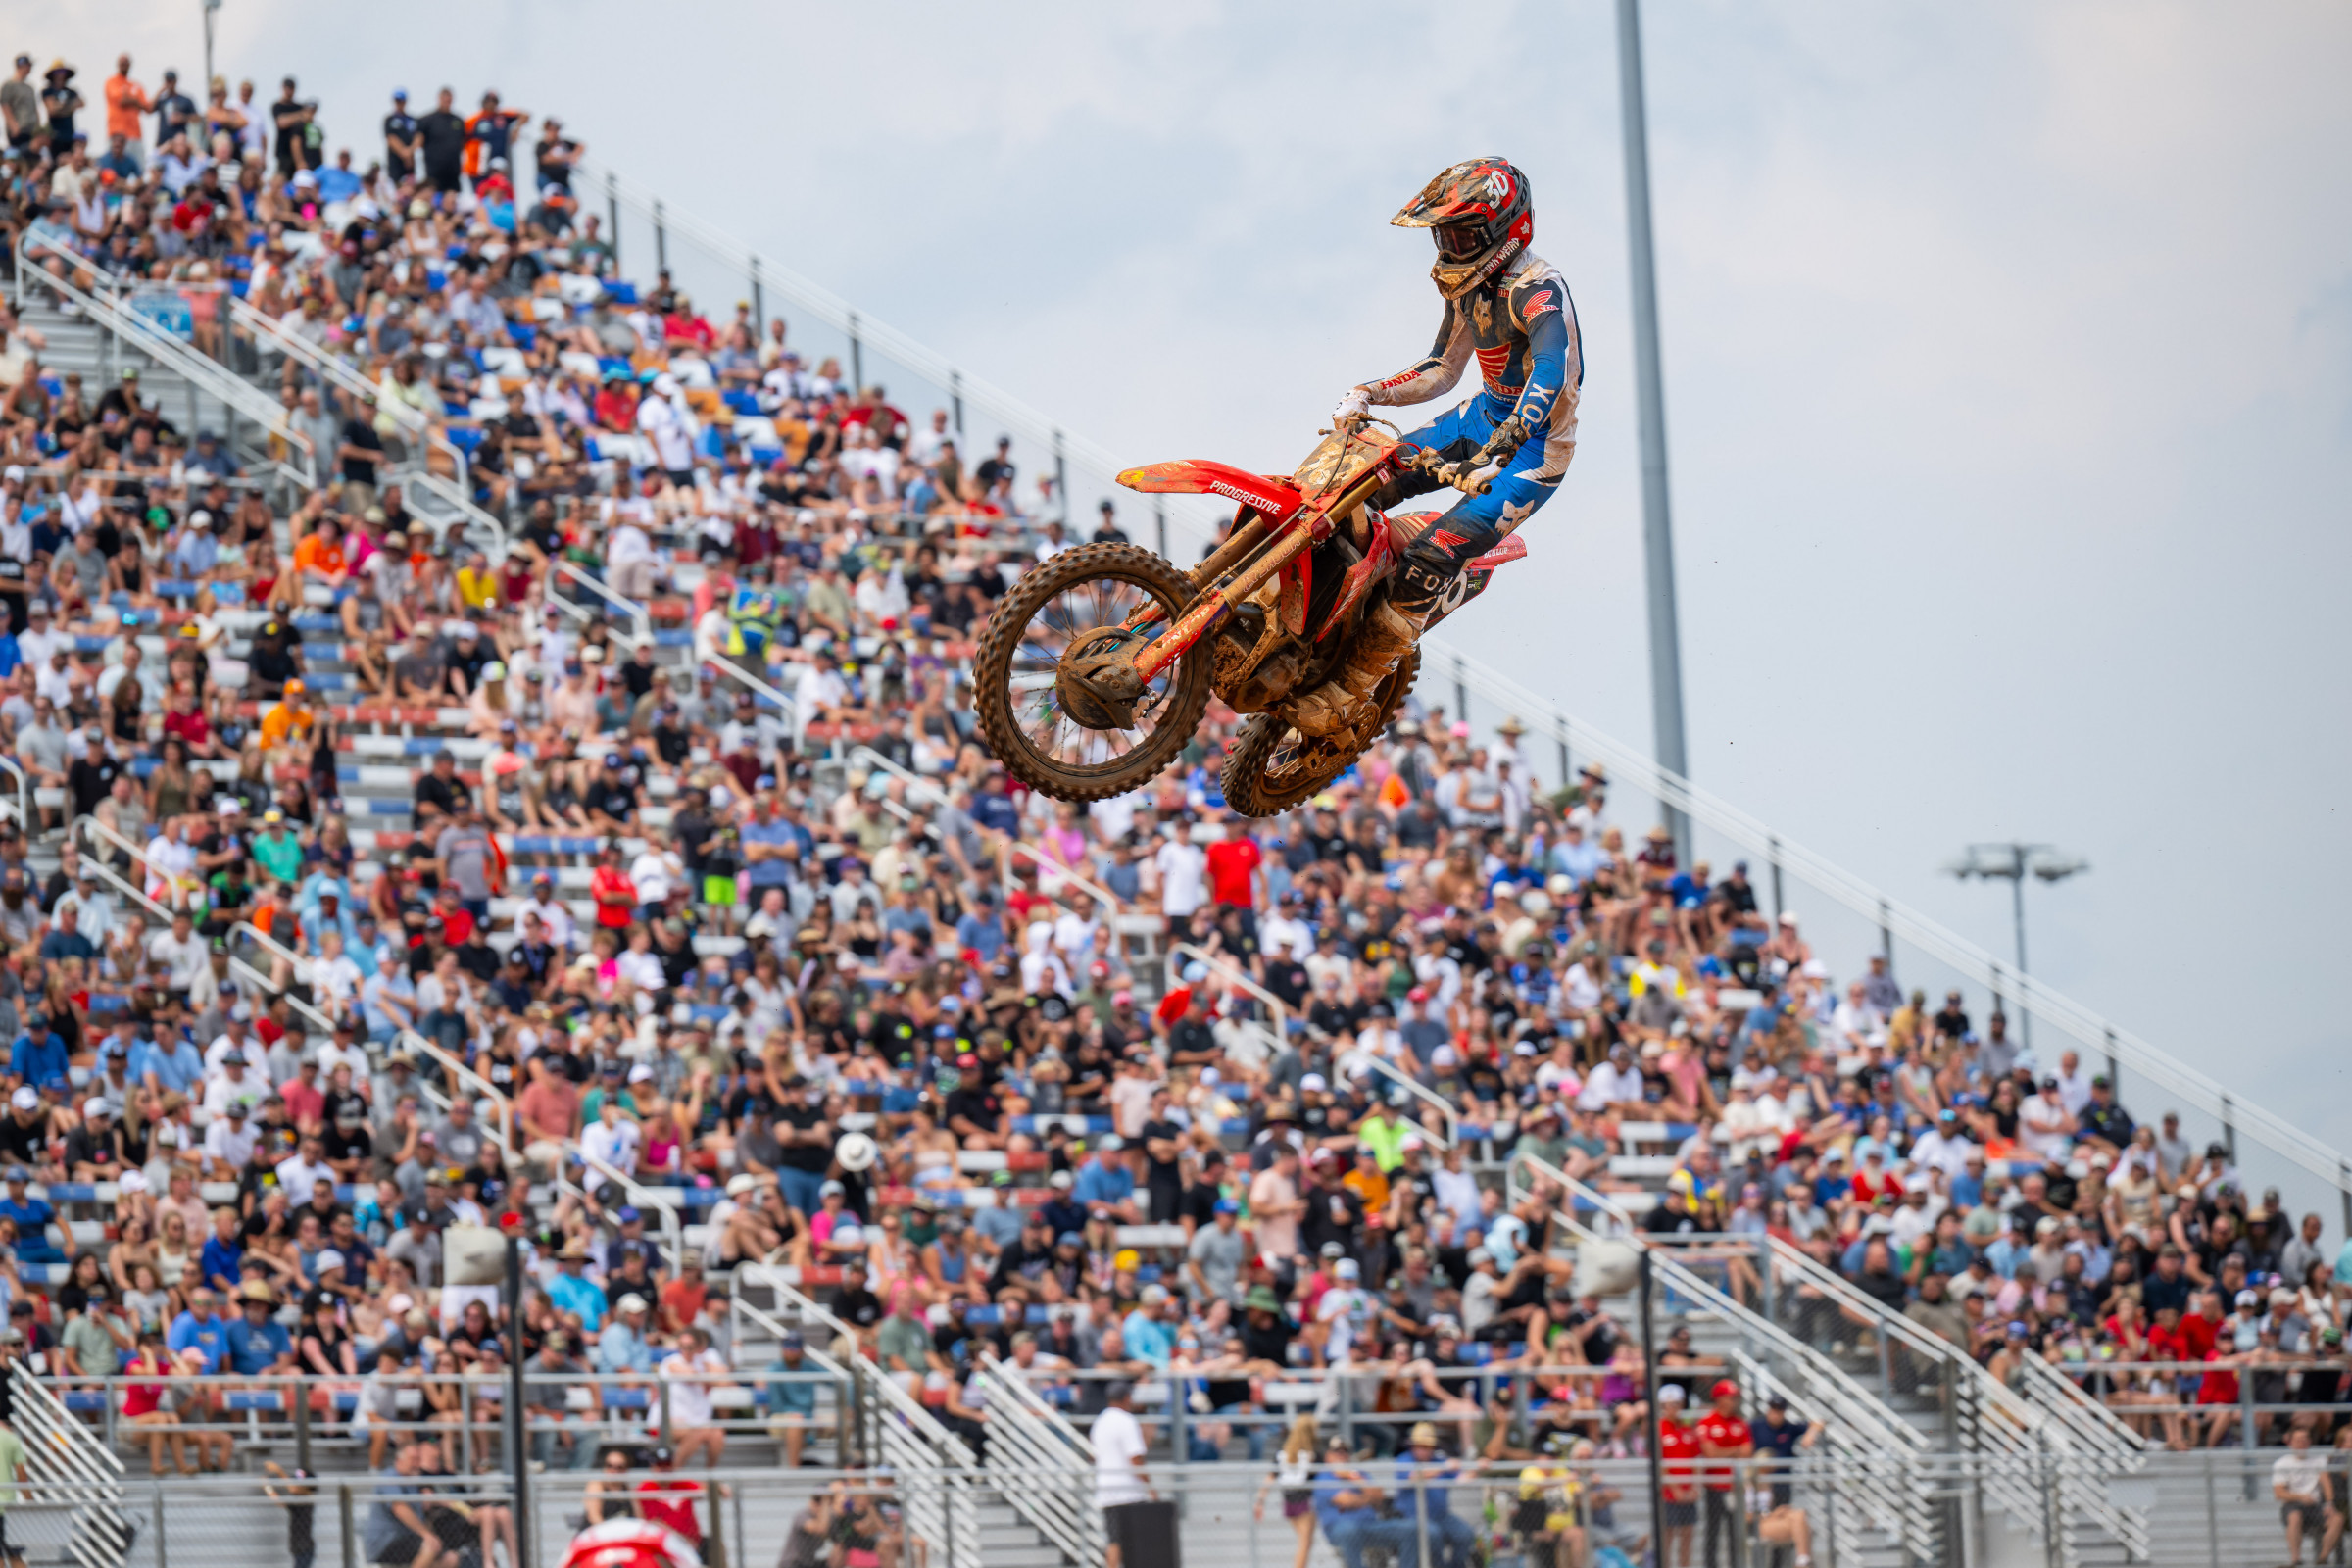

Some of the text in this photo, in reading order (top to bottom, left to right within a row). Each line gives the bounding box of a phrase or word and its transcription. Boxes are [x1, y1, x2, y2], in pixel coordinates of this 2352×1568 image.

[1481, 170, 1509, 209] 30
[1521, 382, 1555, 439] FOX
[1209, 479, 1282, 514] PROGRESSIVE
[1429, 535, 1455, 559] HONDA
[1404, 564, 1454, 594] FOX
